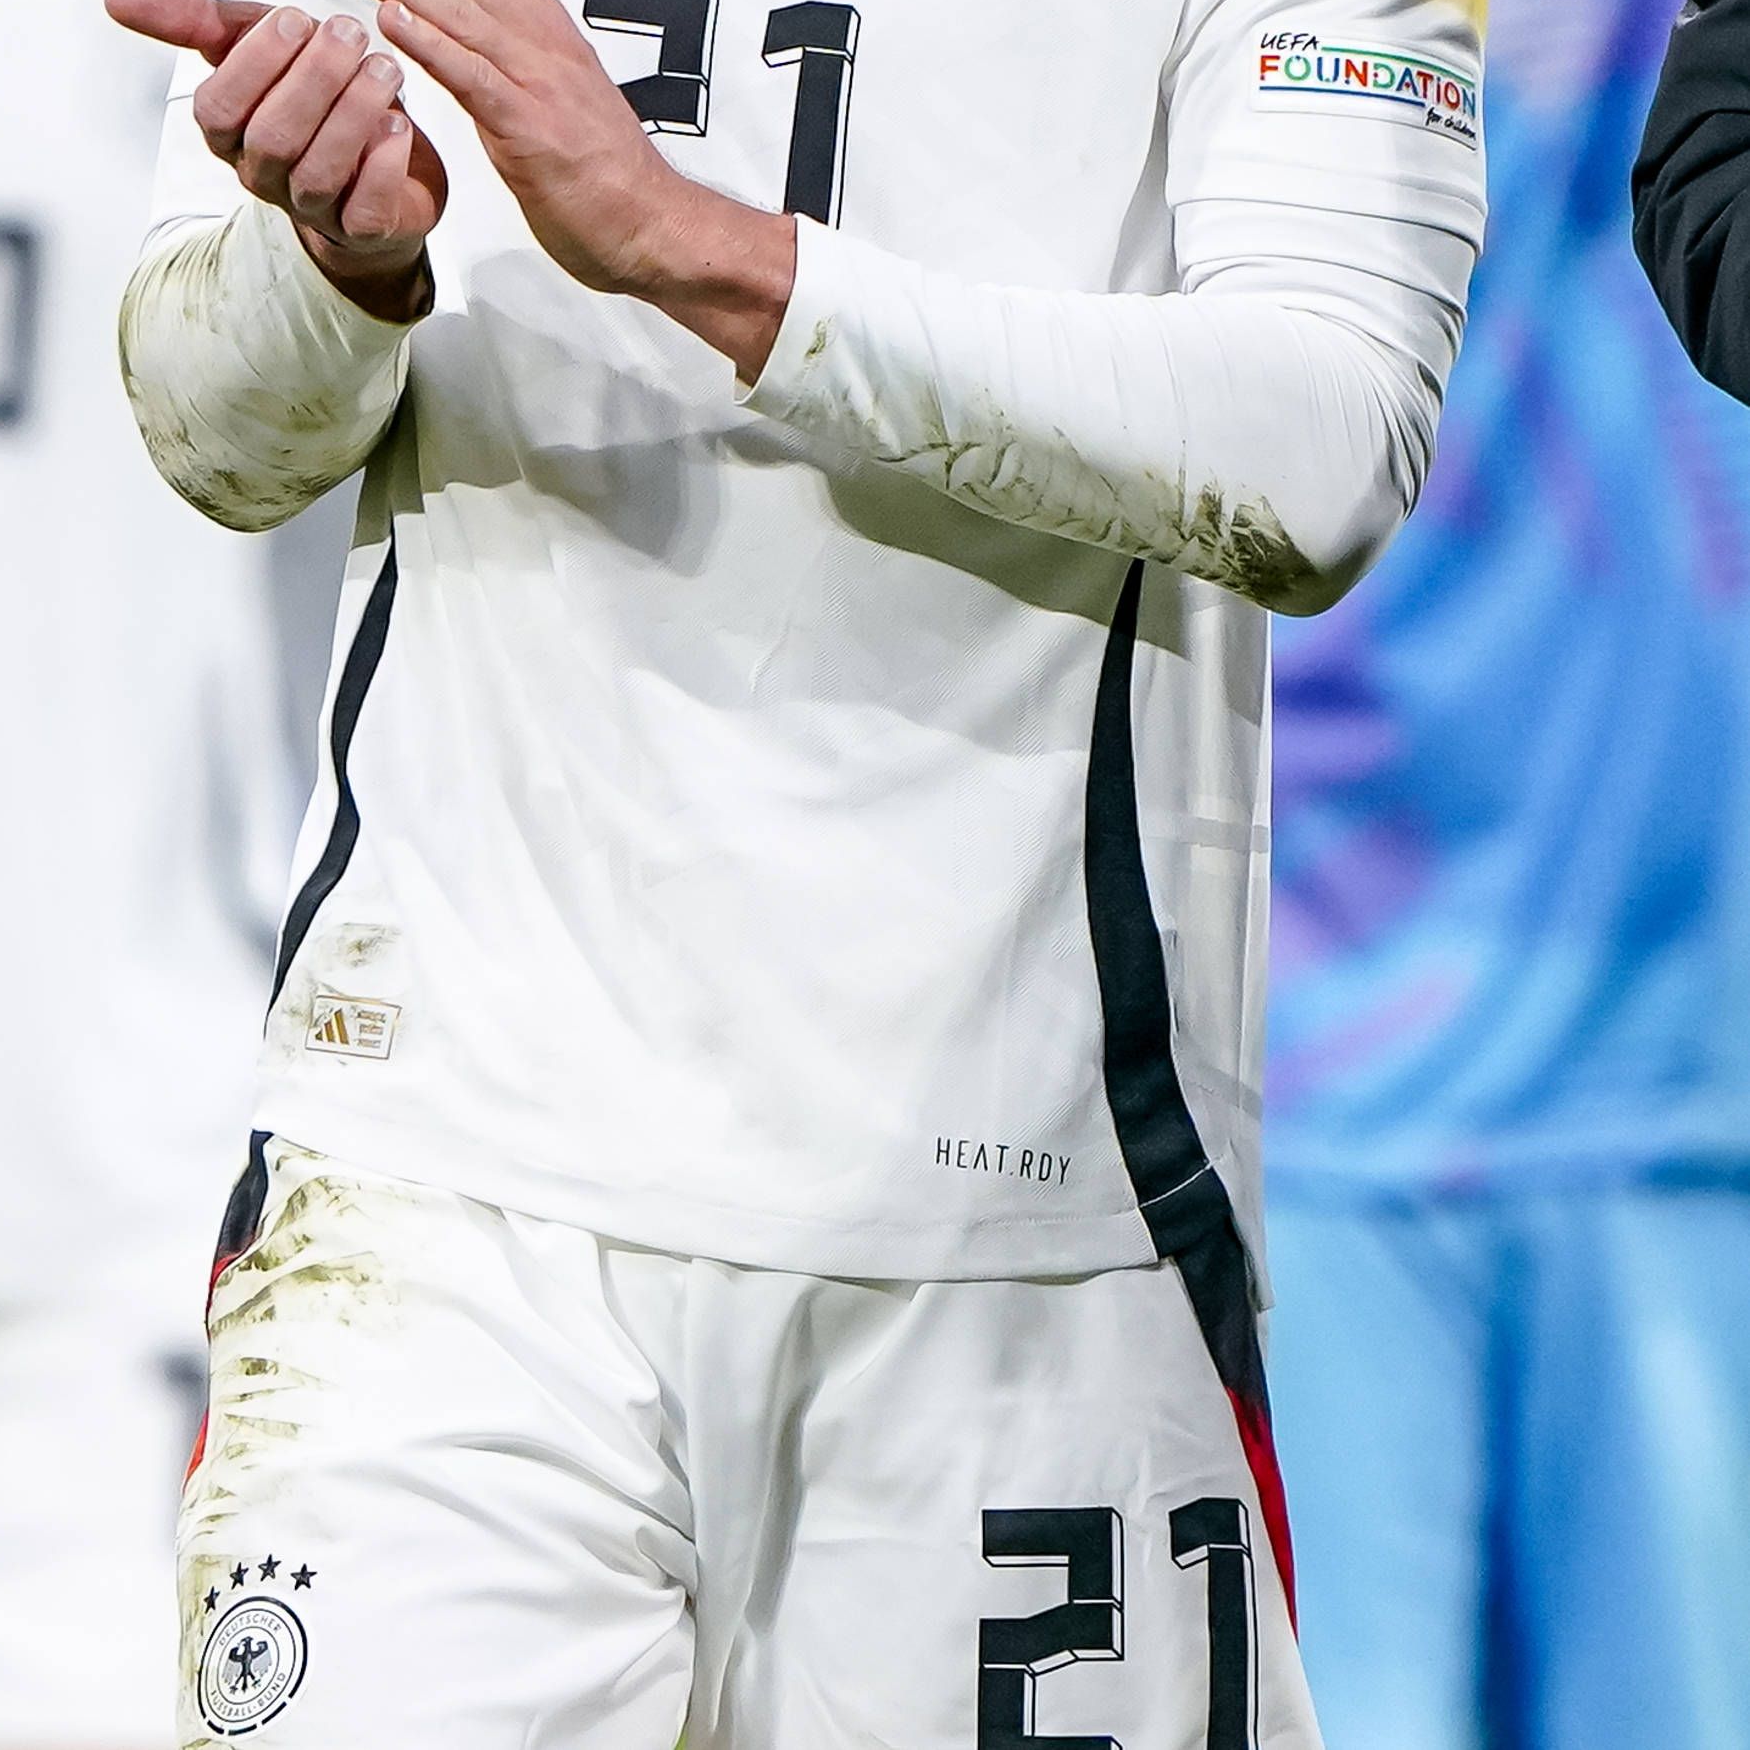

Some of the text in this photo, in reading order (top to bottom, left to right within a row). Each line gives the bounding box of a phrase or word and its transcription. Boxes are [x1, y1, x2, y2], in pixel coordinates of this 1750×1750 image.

[1261, 32, 1320, 51] UEFA
[218, 1613, 282, 1647] DEUTSCHER
[977, 1497, 1258, 1750] 21
